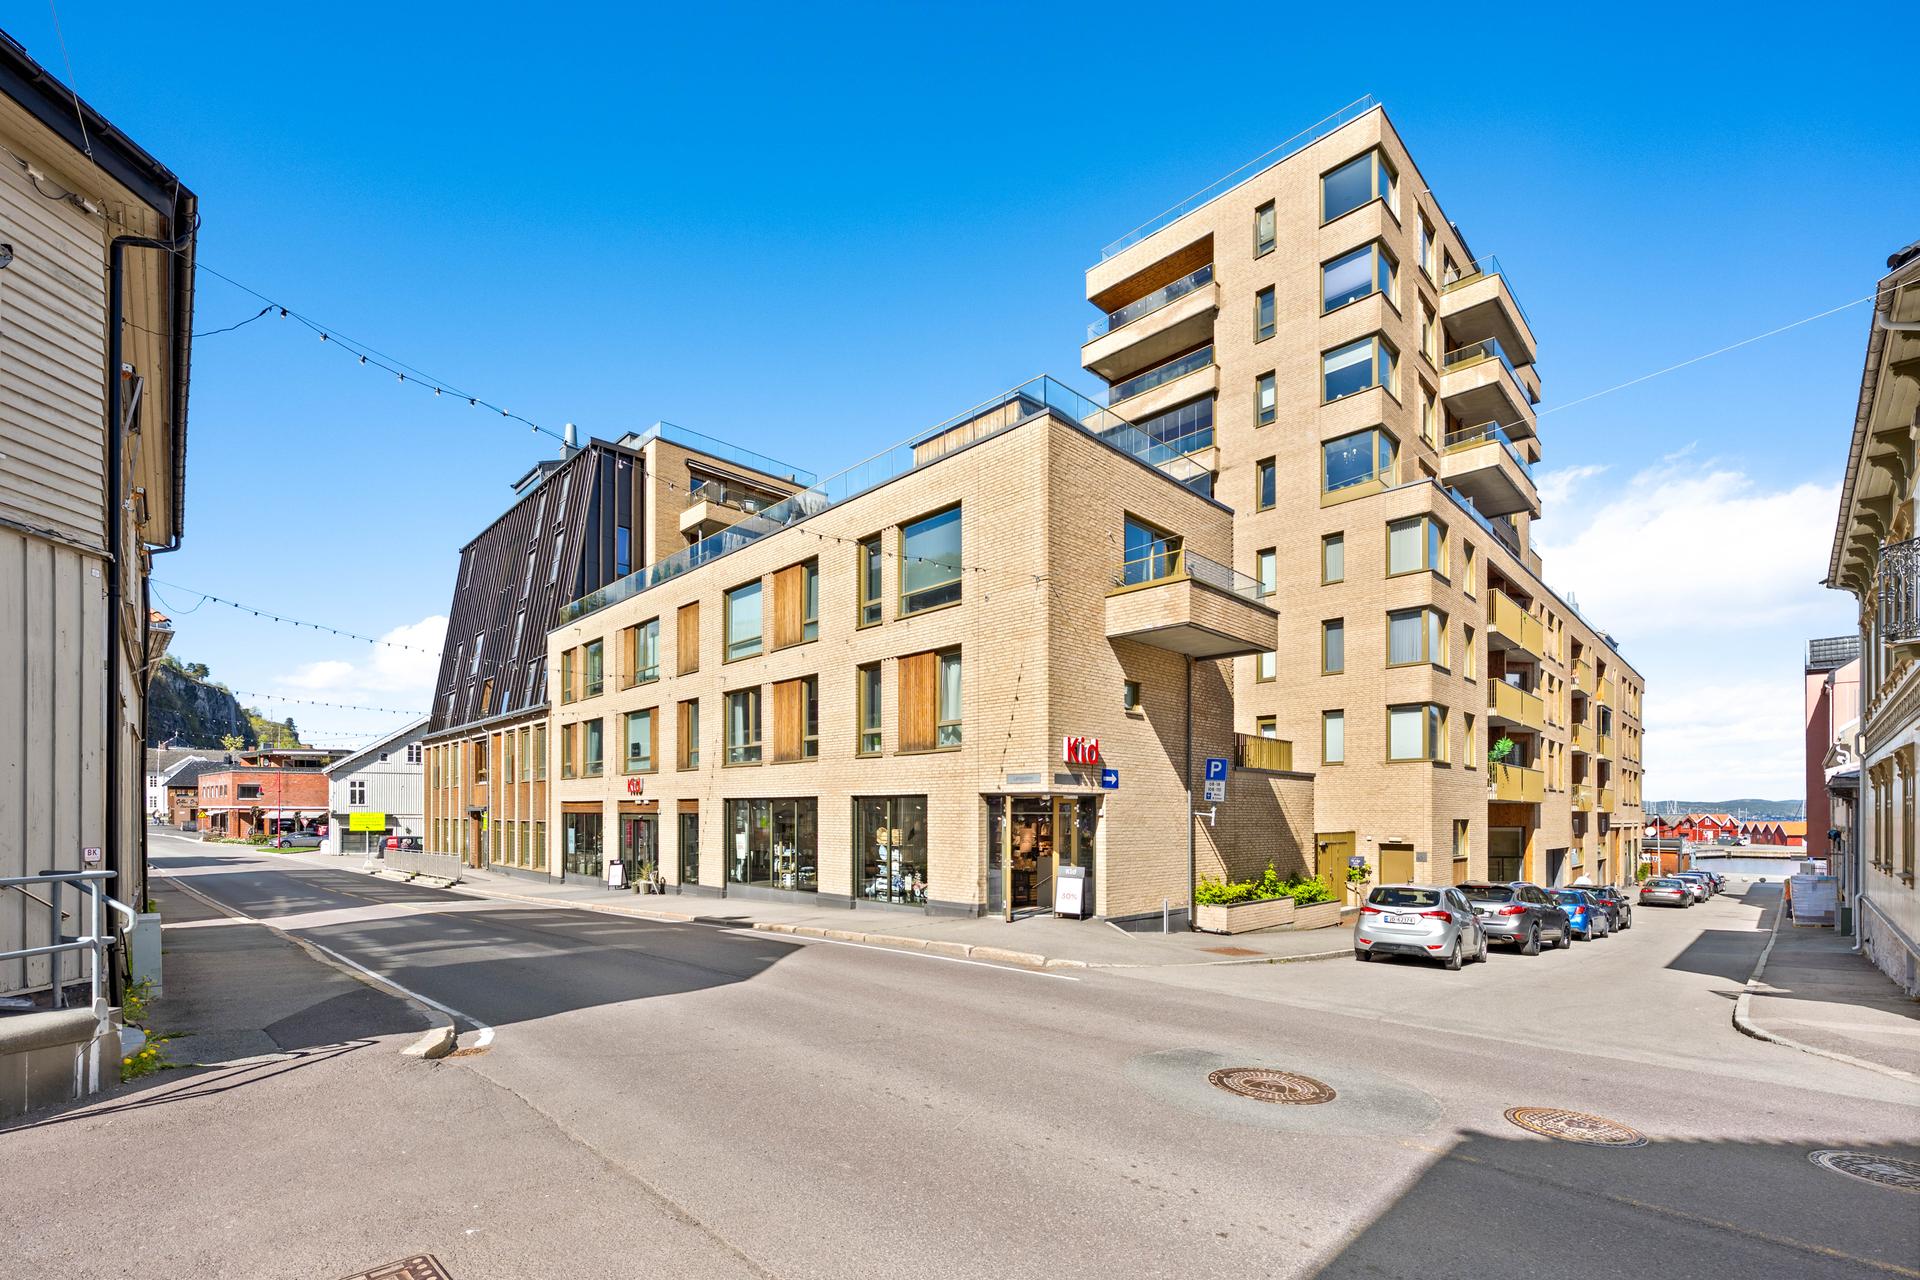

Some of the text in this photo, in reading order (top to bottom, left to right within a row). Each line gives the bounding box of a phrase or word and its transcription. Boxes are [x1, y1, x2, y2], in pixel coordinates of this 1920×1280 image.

[1064, 736, 1099, 765] Kid
[1210, 761, 1222, 778] P
[628, 777, 641, 793] Kid
